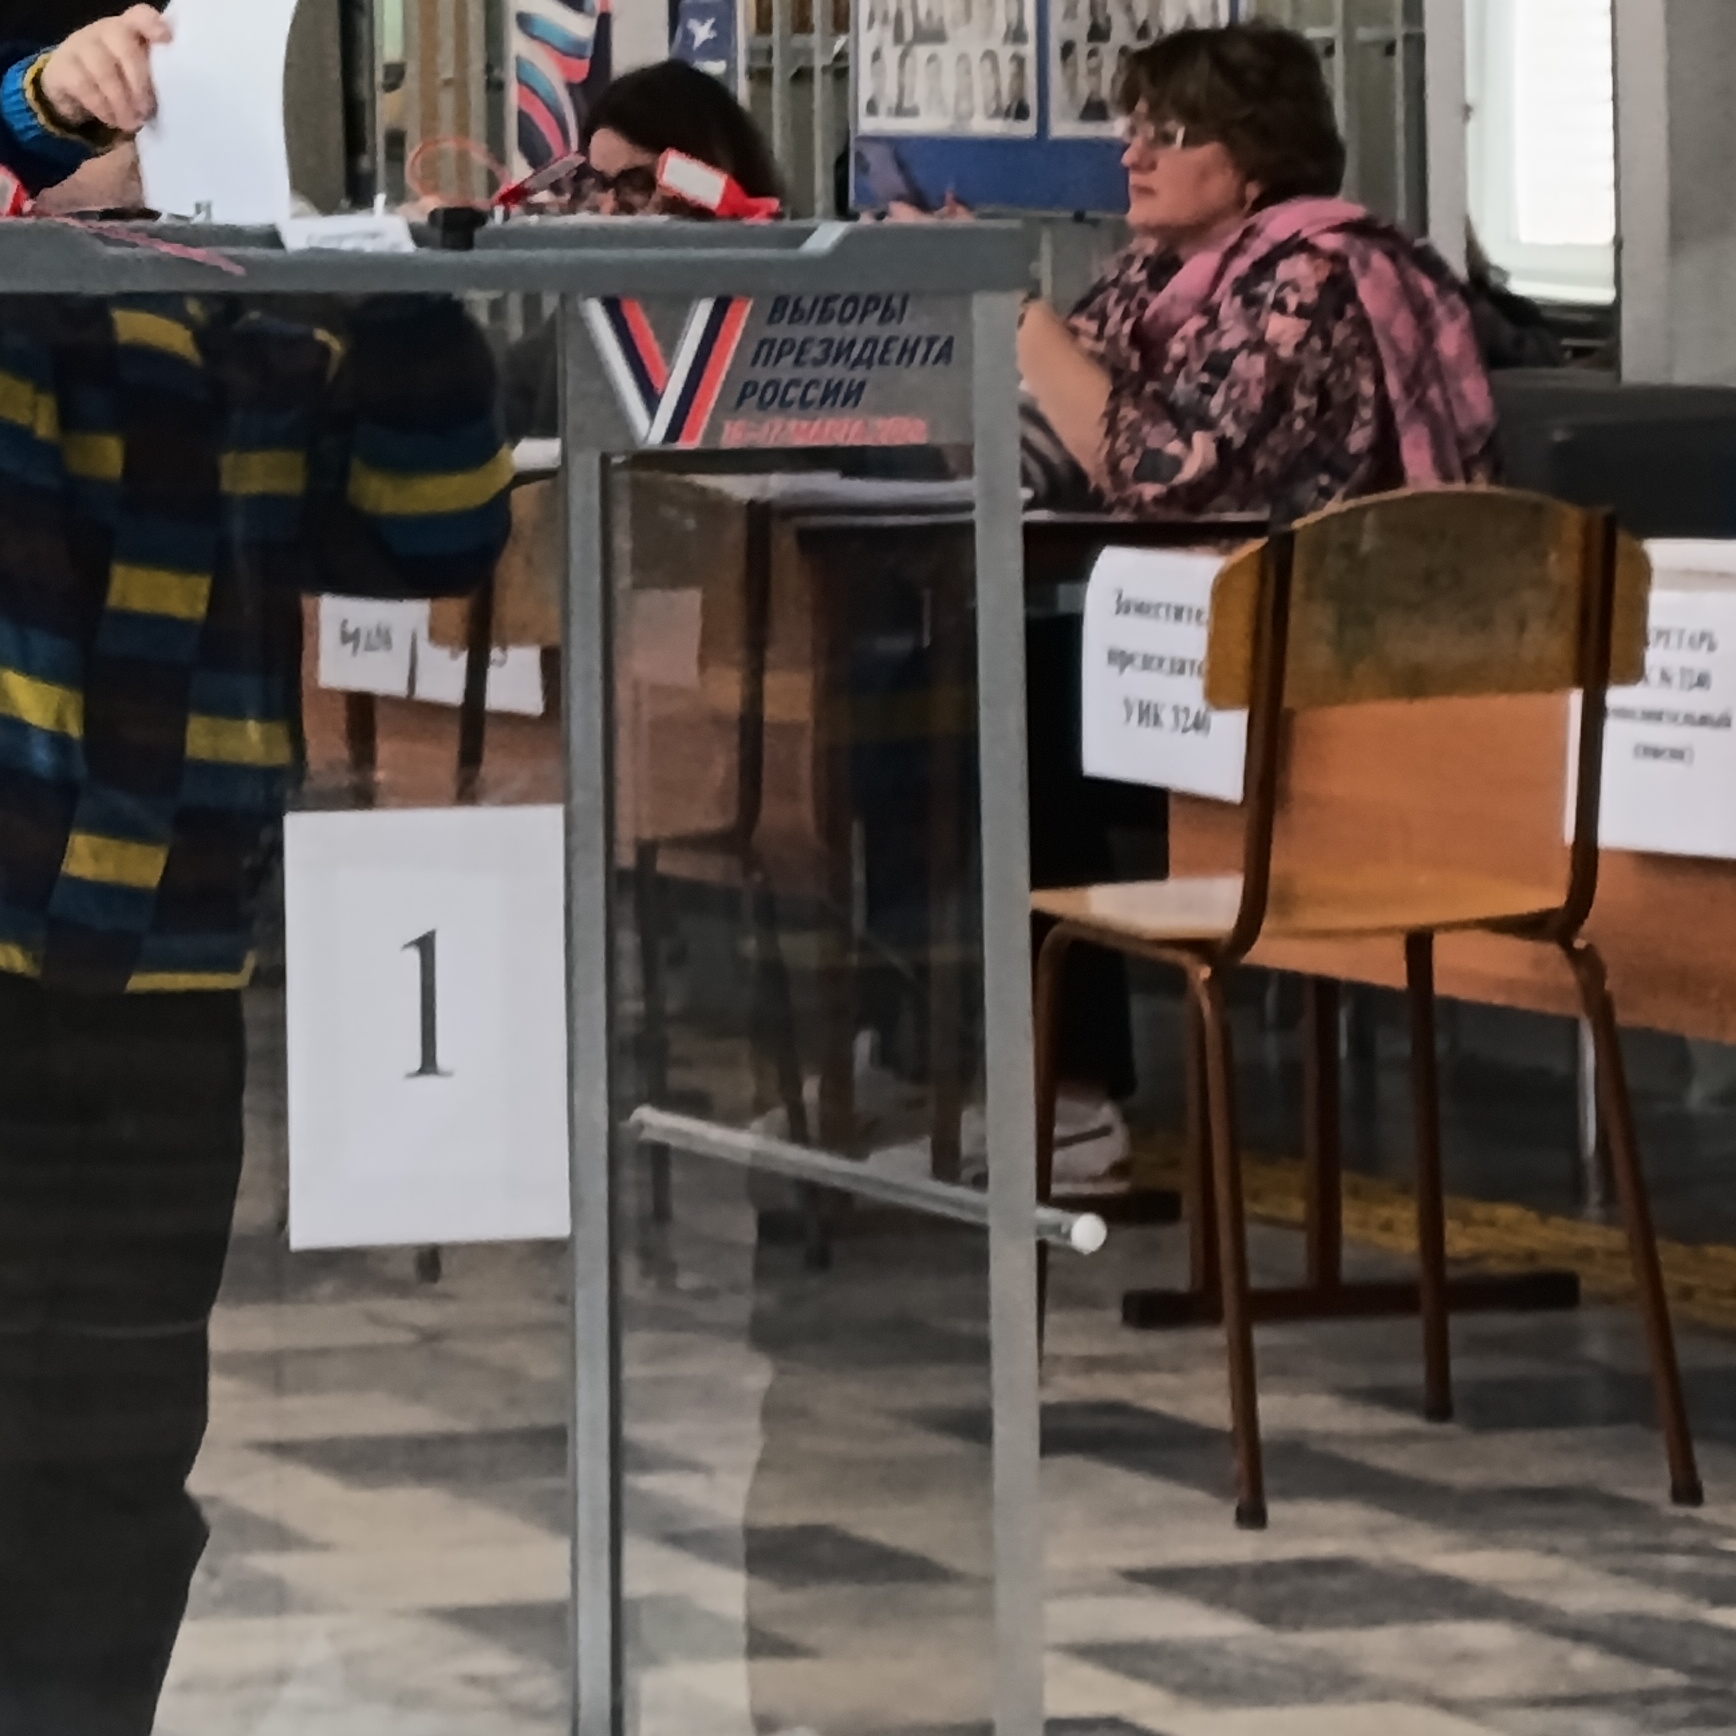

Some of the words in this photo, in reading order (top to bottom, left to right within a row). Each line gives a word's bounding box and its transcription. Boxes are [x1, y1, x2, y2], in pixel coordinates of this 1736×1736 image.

[766, 293, 910, 326] ВЫБОРЫ
[750, 334, 956, 371] ПРЕЗИДЕНТА
[735, 378, 869, 412] РОССИИ
[1114, 588, 1210, 626] Заместите
[400, 927, 456, 1080] 1
